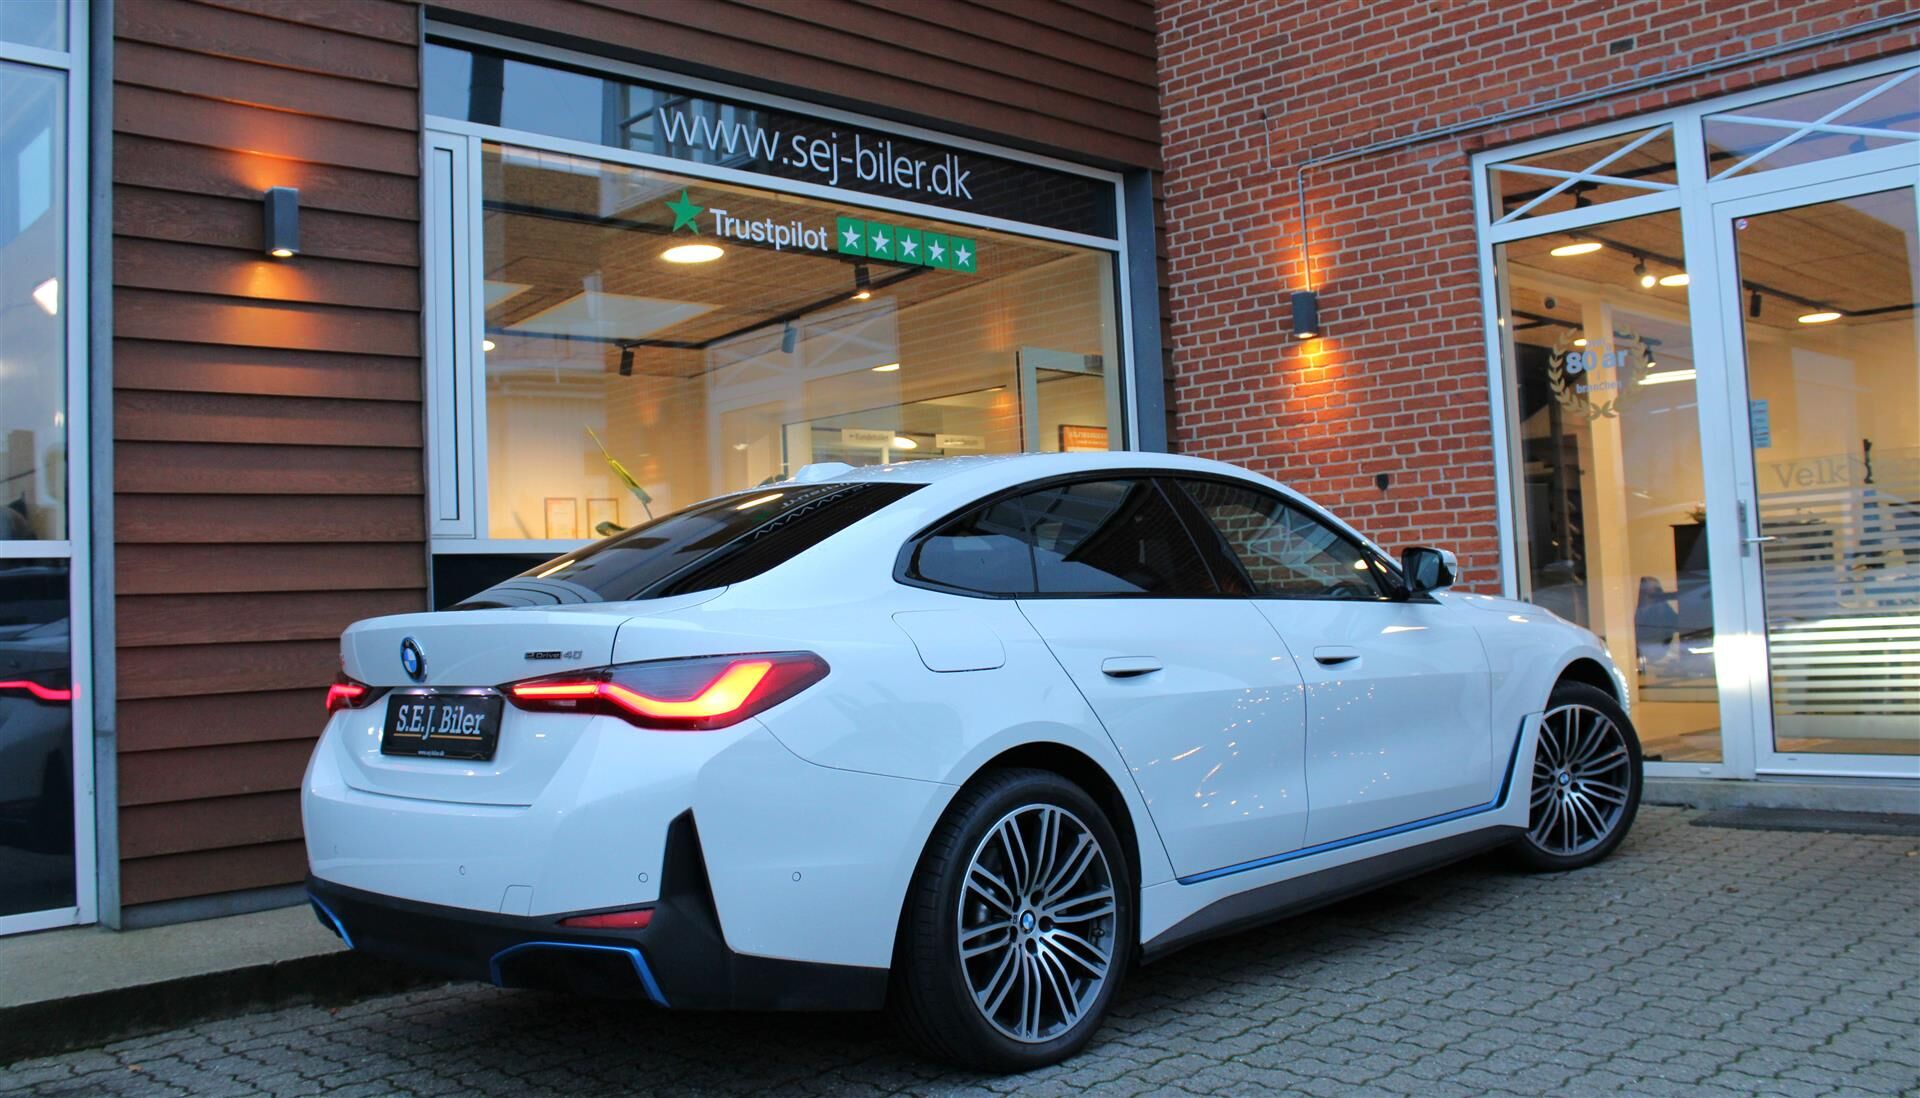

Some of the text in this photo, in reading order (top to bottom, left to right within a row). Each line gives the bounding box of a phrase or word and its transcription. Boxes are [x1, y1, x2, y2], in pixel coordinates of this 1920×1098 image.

[659, 107, 973, 200] www.sej-biler.dk
[709, 208, 828, 251] Trustpilot
[1566, 351, 1597, 374] 80
[396, 705, 485, 740] S.E.J. Biler
